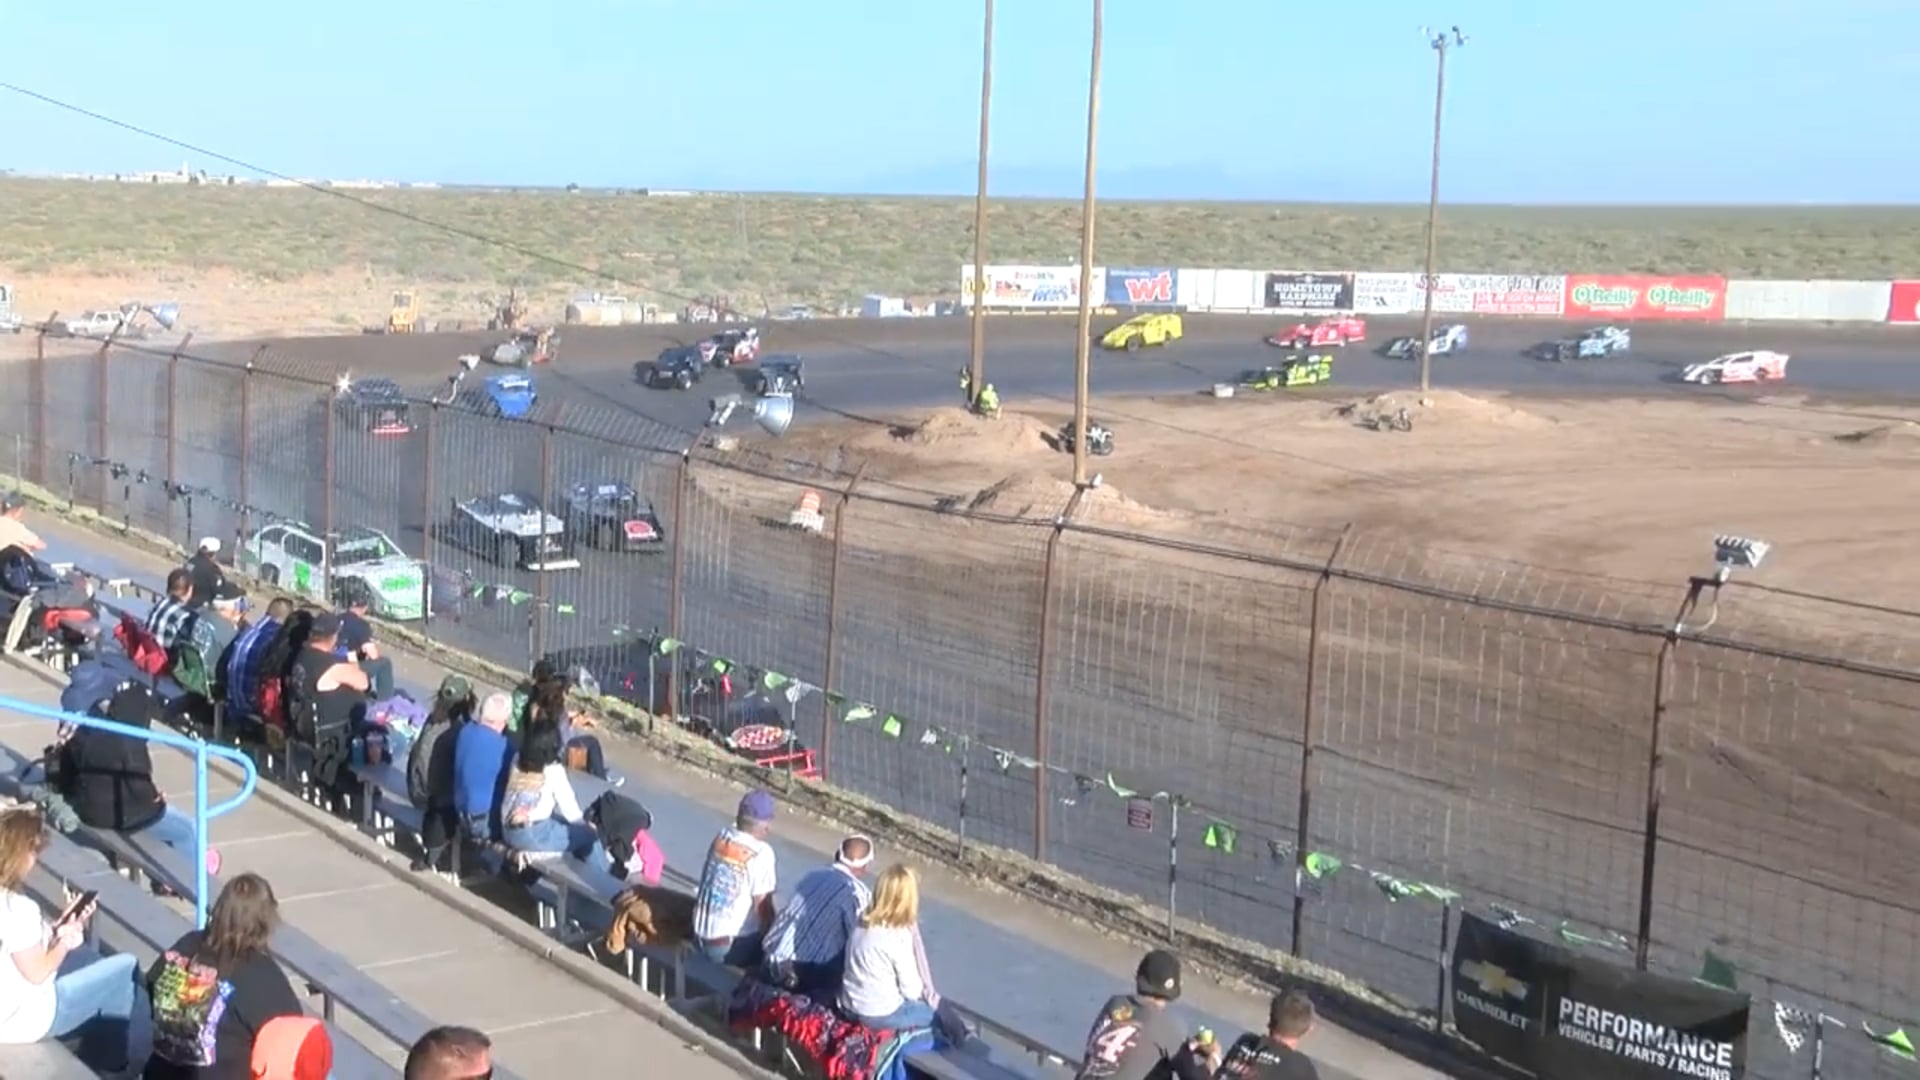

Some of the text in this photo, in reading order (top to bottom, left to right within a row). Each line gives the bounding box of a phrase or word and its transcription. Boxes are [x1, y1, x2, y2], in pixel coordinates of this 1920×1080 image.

[1273, 283, 1342, 293] HOMETOWN
[1574, 283, 1636, 307] O'Reilly
[1649, 283, 1713, 308] O'Reilly
[1559, 997, 1733, 1068] PERFORMANCE
[1558, 1022, 1614, 1051] VEHICLES
[1624, 1043, 1666, 1068] PARTS
[1677, 1058, 1732, 1080] RACING
